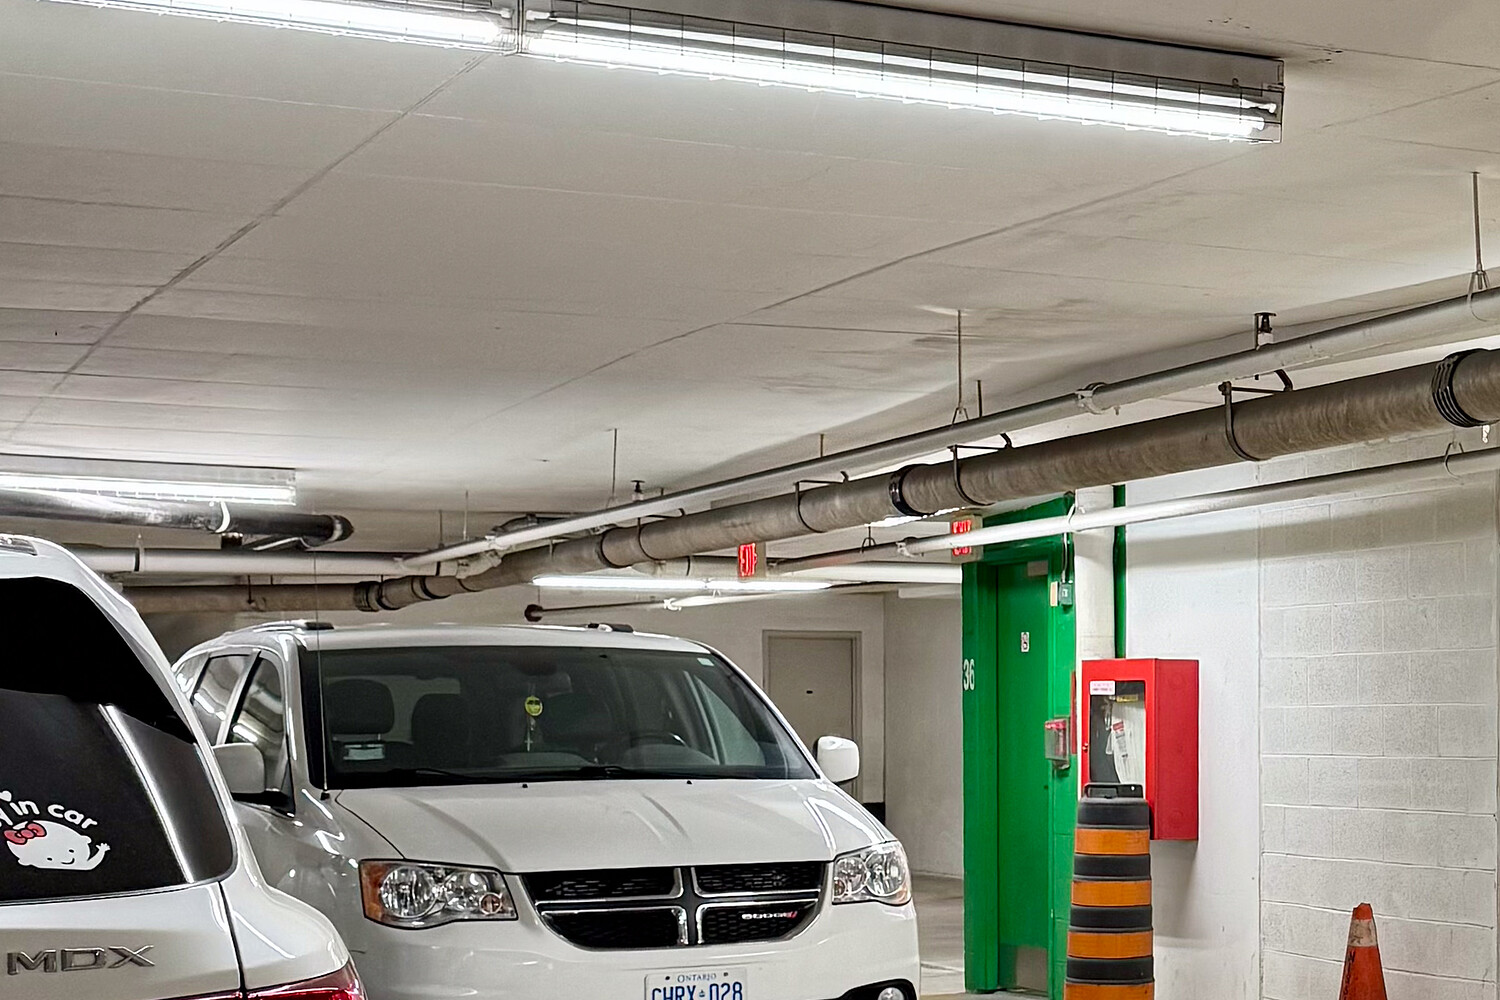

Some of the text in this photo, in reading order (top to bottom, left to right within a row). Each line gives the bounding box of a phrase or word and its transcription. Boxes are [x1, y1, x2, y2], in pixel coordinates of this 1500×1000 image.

[963, 658, 975, 691] 36
[9, 800, 98, 829] in car
[7, 944, 155, 976] MDX
